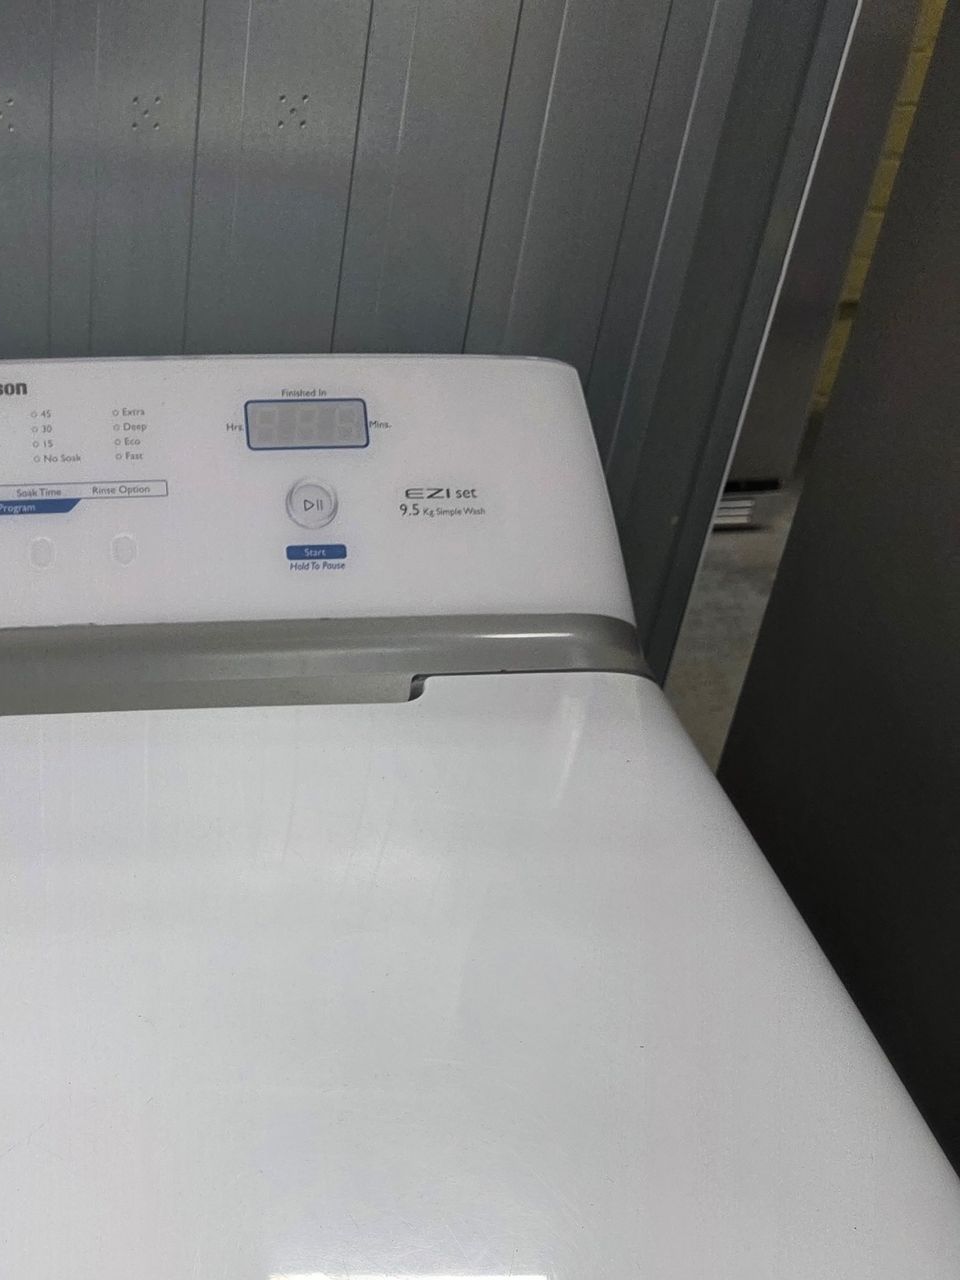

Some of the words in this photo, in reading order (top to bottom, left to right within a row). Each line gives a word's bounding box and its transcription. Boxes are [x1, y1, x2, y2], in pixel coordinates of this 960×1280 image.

[281, 389, 316, 397] Finished
[318, 389, 327, 397] In
[41, 410, 51, 418] 45
[122, 408, 145, 417] Extra
[42, 424, 52, 433] 30
[123, 423, 147, 433] Deep
[43, 439, 53, 448] 15
[124, 437, 141, 446] Eco
[44, 454, 58, 463] No
[61, 453, 81, 463] Soak
[125, 452, 143, 460] Fast
[16, 488, 37, 498] Soak
[39, 488, 62, 497] Time
[92, 486, 116, 495] Rinse
[119, 485, 150, 495] Option
[456, 488, 477, 498] set
[399, 505, 419, 516] 9.5
[423, 508, 434, 517] Kg
[436, 508, 462, 517] Simple
[463, 507, 485, 515] Wash
[304, 548, 326, 557] Start
[290, 562, 309, 571] Hold
[311, 562, 320, 570] To
[322, 561, 345, 570] Pause
